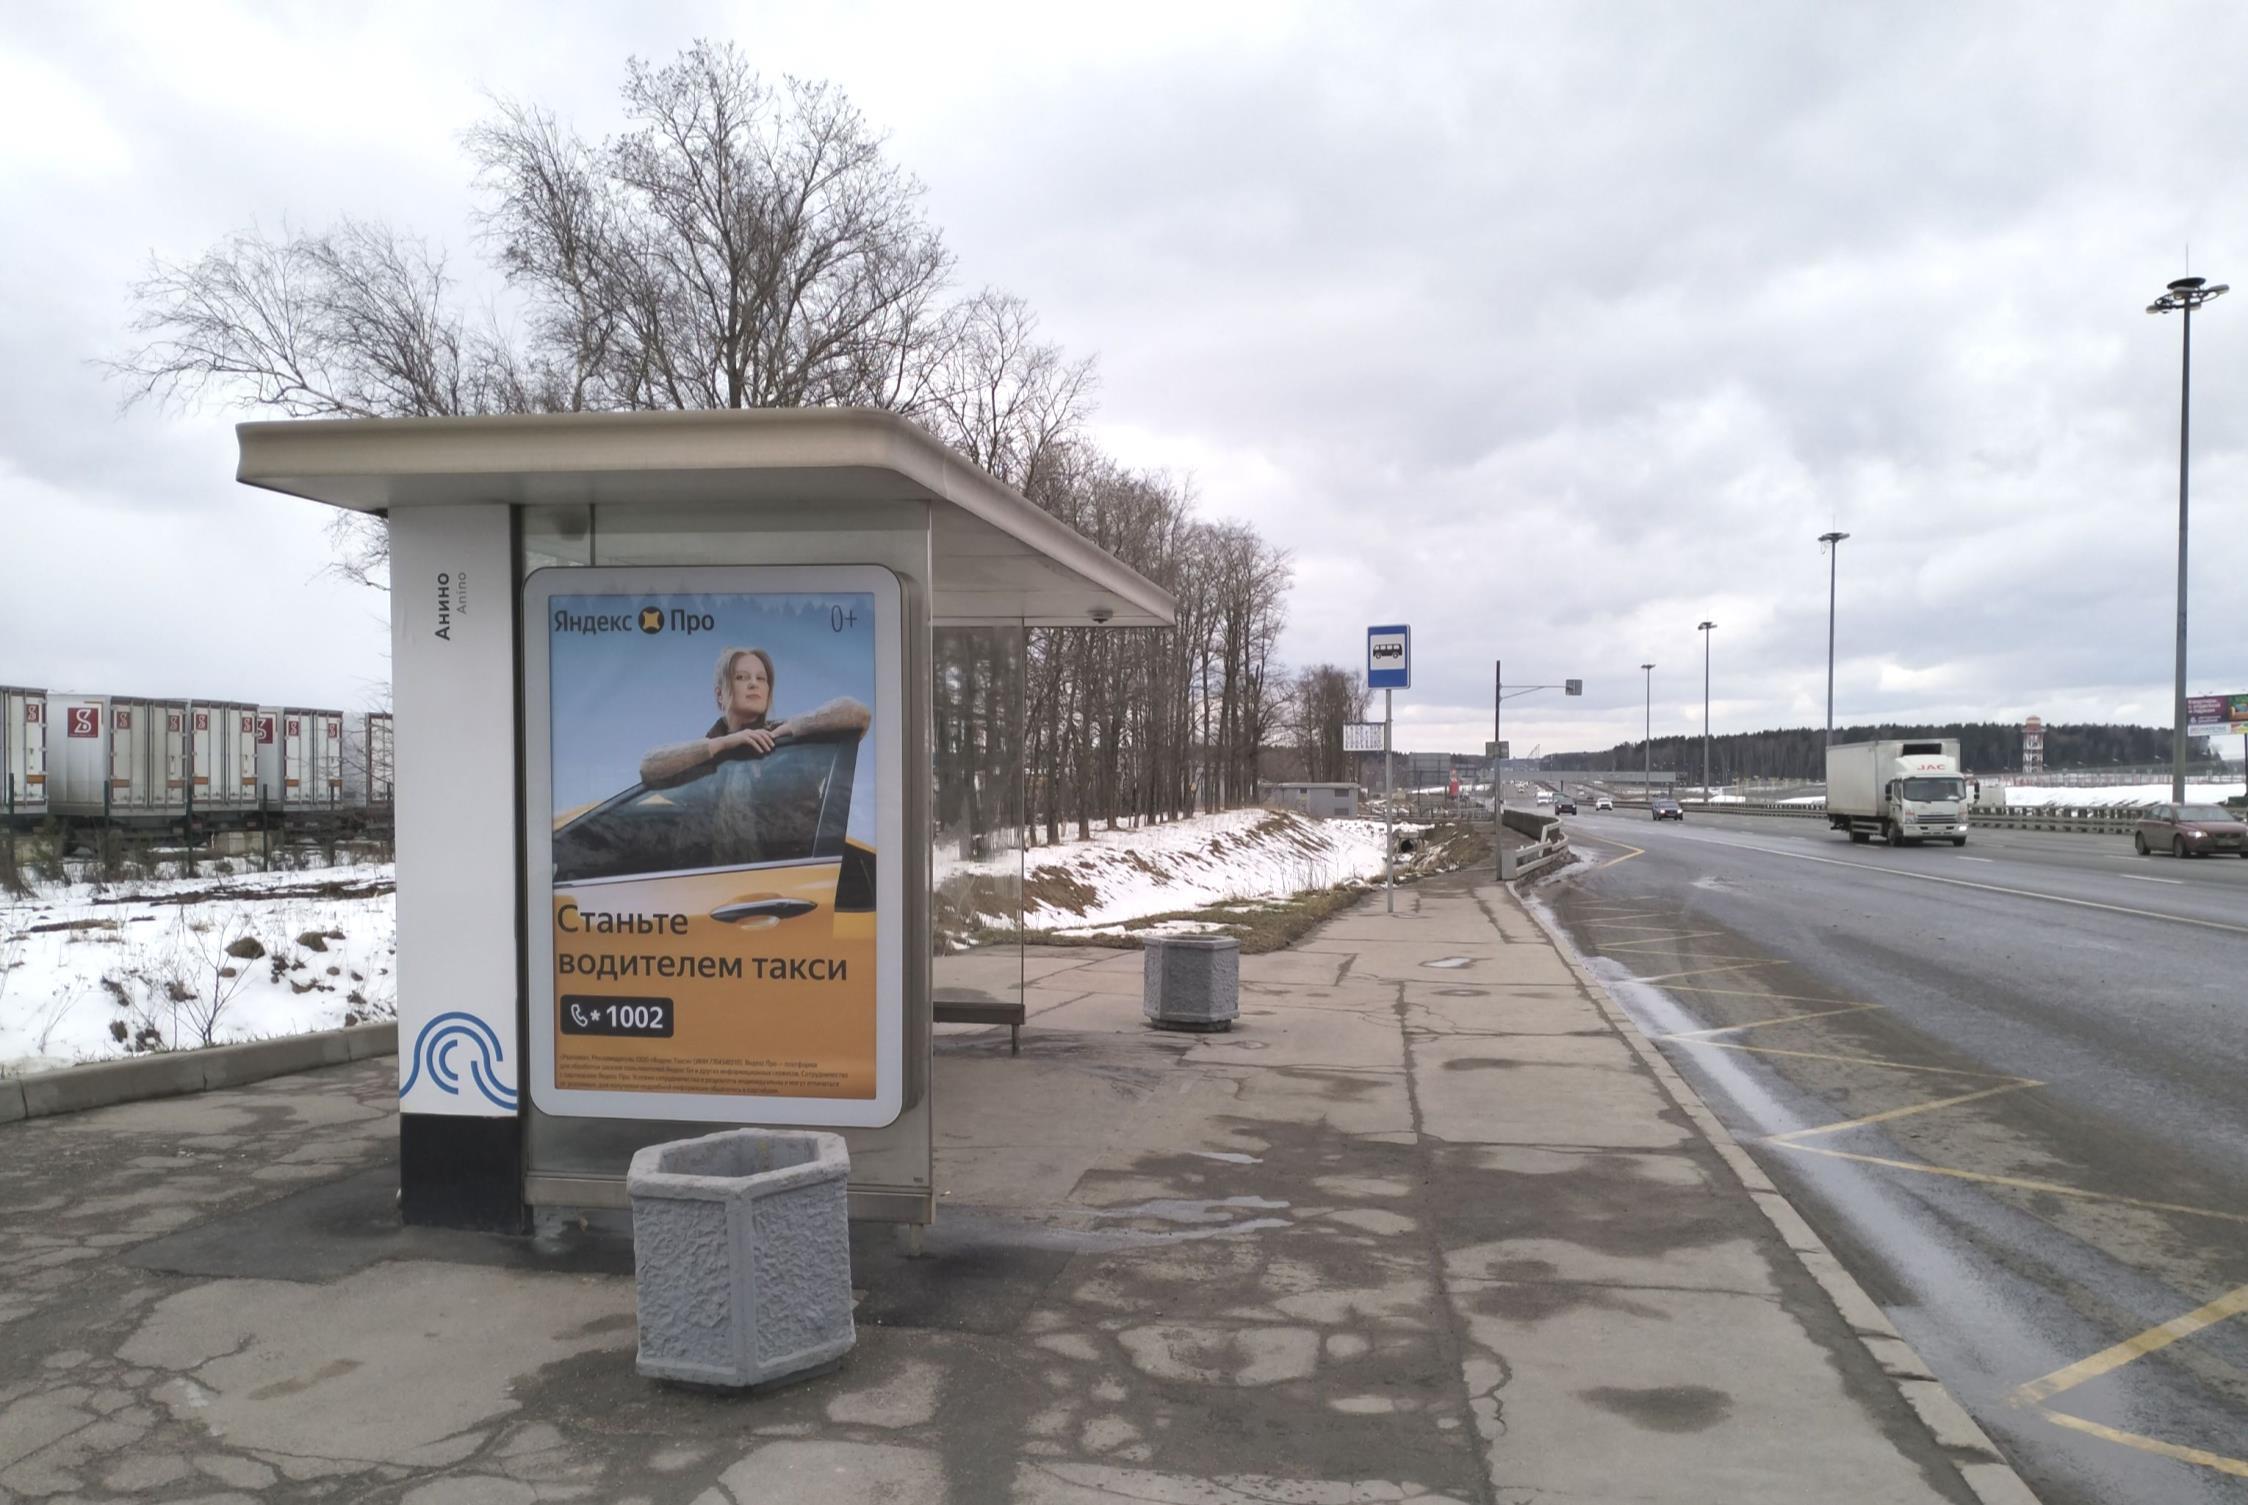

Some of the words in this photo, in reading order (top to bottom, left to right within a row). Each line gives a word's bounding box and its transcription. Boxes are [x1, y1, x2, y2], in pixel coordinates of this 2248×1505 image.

[435, 572, 450, 641] Анино
[456, 572, 467, 614] Anino
[554, 608, 633, 635] Яндекс
[670, 609, 715, 635] Про
[830, 604, 858, 633] 0+
[557, 904, 689, 936] Станьте
[558, 952, 743, 981] водителем
[752, 955, 848, 982] такси
